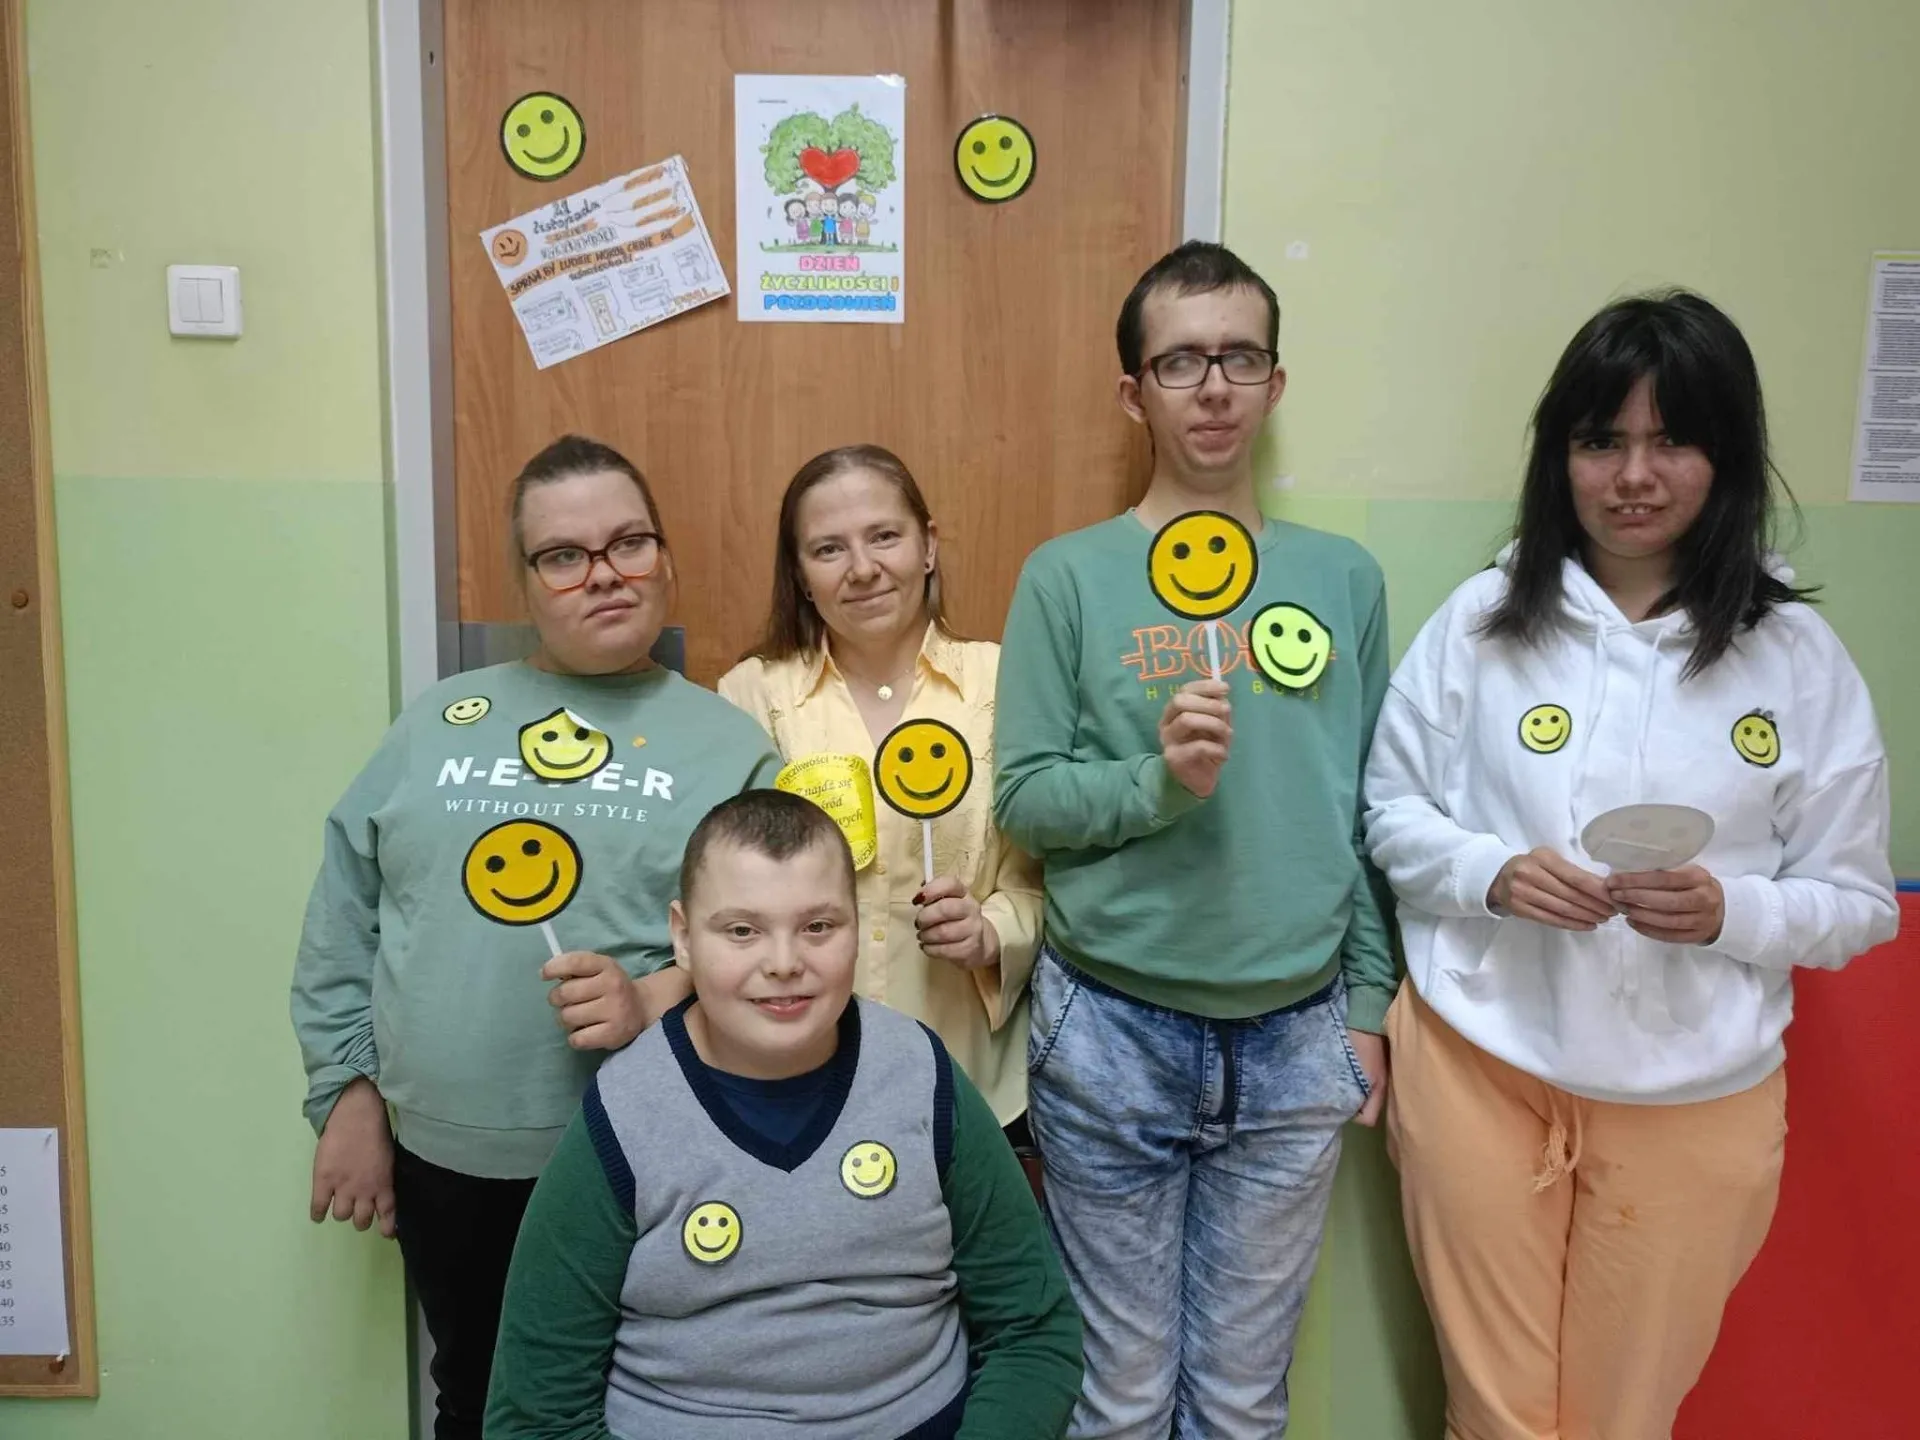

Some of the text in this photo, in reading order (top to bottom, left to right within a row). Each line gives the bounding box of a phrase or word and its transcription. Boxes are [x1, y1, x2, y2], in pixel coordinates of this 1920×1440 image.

[799, 251, 860, 271] DZIEŃ
[760, 270, 889, 292] ŻYCZLIWOŚCI
[763, 290, 897, 311] POZDROWIEŃ
[436, 756, 674, 801] N-E--E-R
[445, 799, 649, 823] WITHOUT STYLE
